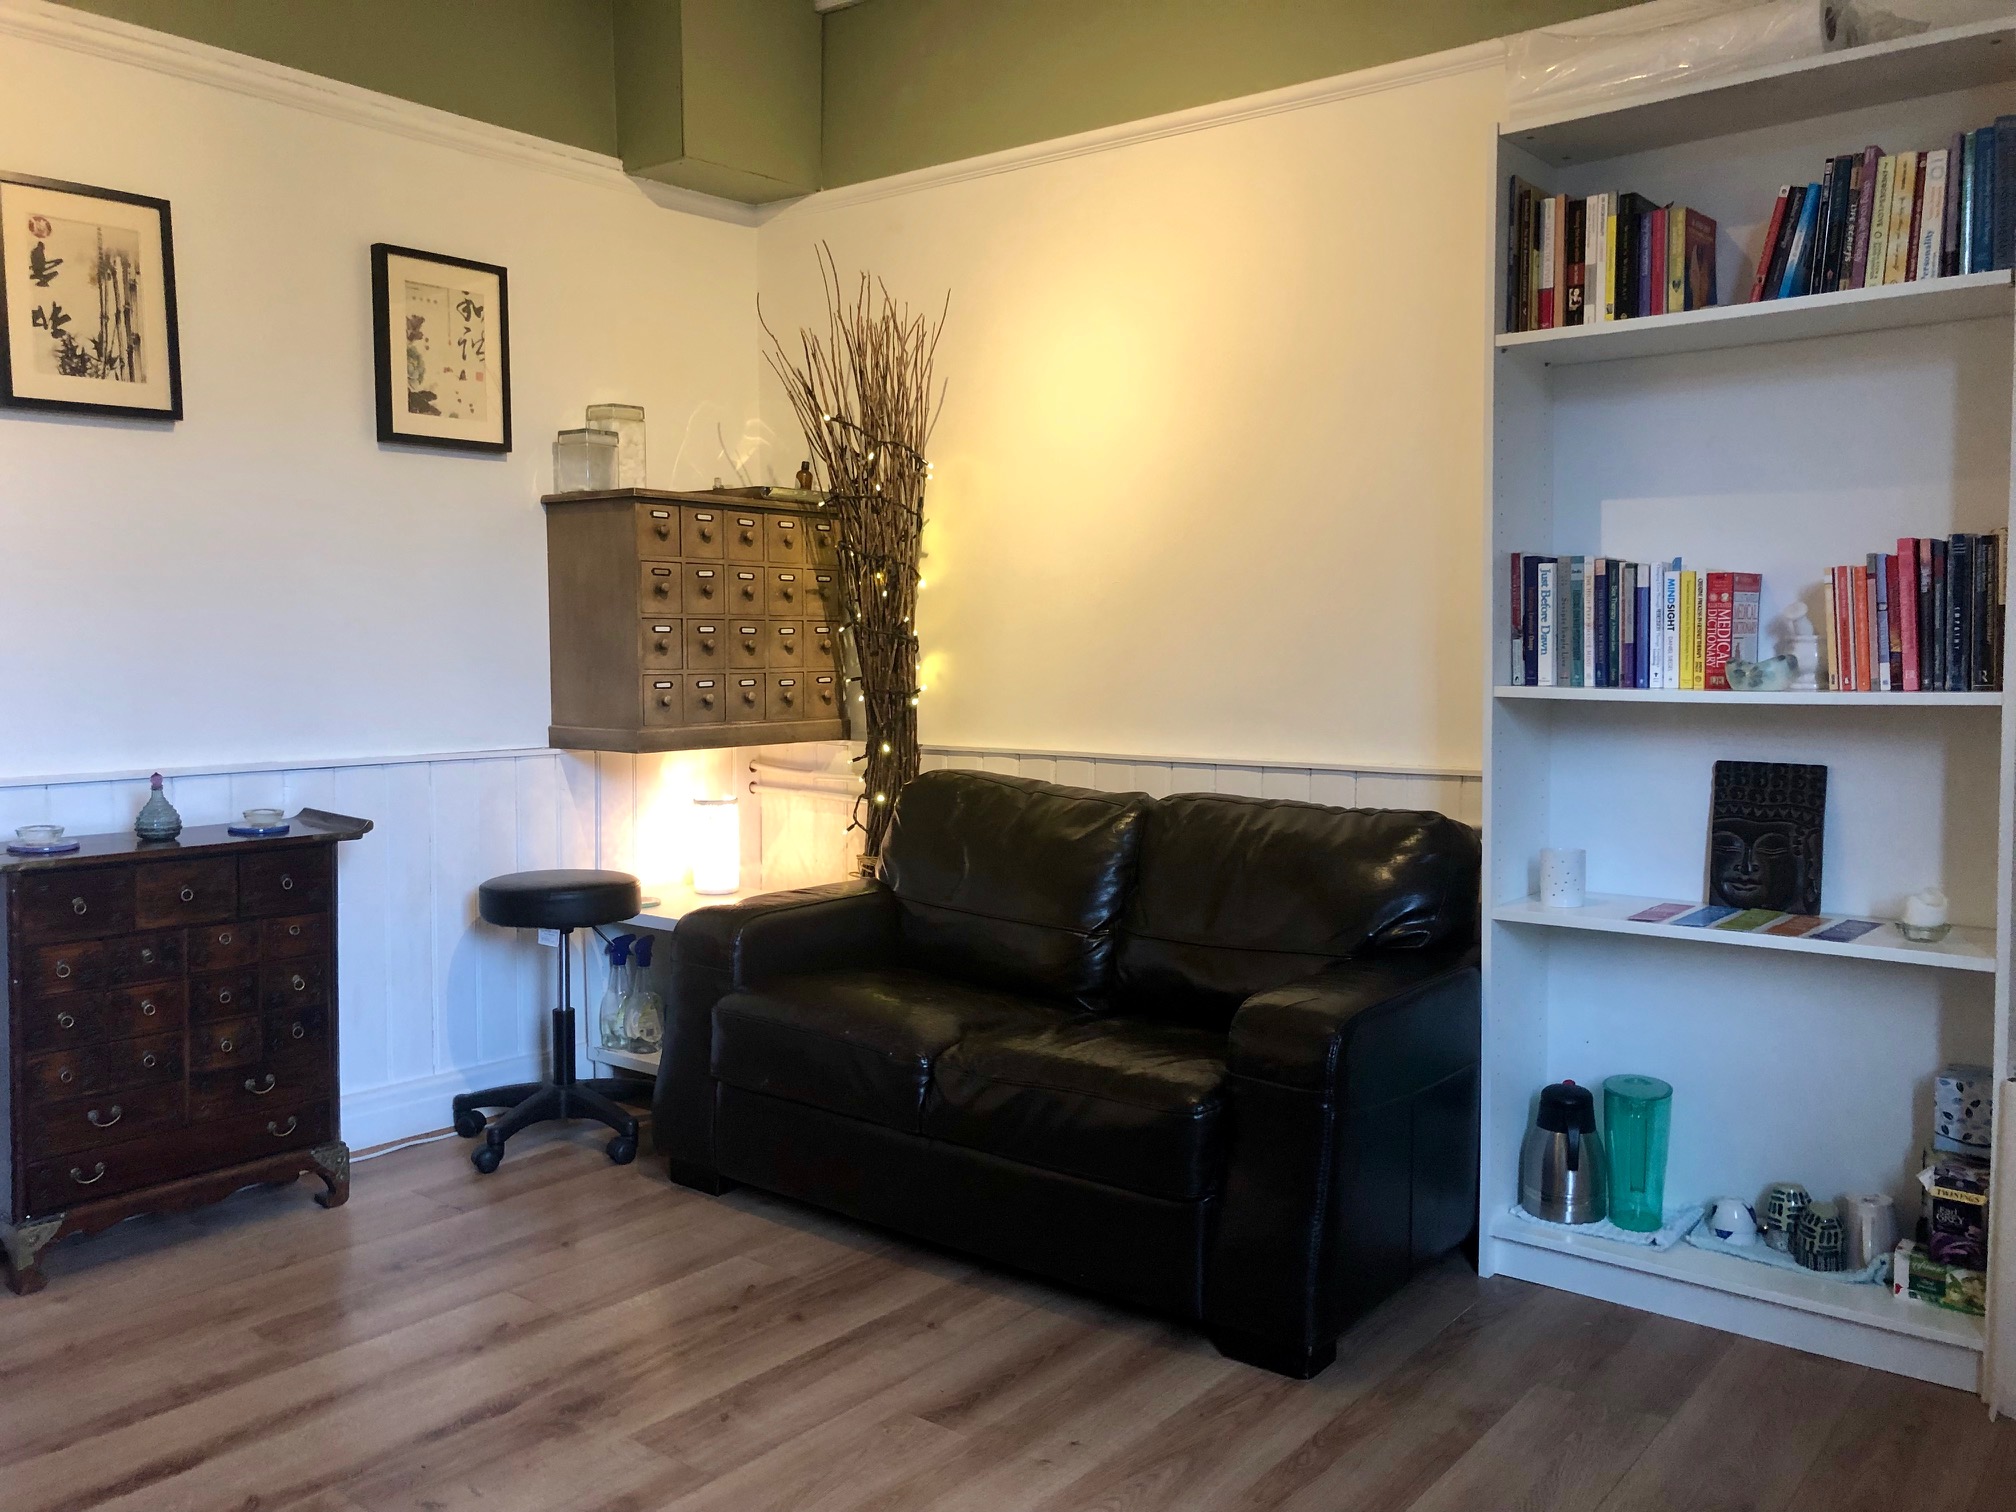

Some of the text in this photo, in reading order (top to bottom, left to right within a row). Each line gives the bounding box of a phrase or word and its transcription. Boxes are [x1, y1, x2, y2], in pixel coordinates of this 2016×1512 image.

[1842, 224, 1854, 261] SCRIPTS
[1540, 569, 1550, 655] Just Before Dawn
[1666, 578, 1675, 631] MINDSIGHT
[1706, 608, 1716, 667] DICTIONARY
[1716, 609, 1730, 667] MEDICAL
[1936, 1188, 1980, 1203] TWININGS
[1938, 1206, 1958, 1216] Earl
[1936, 1213, 1965, 1226] GREY
